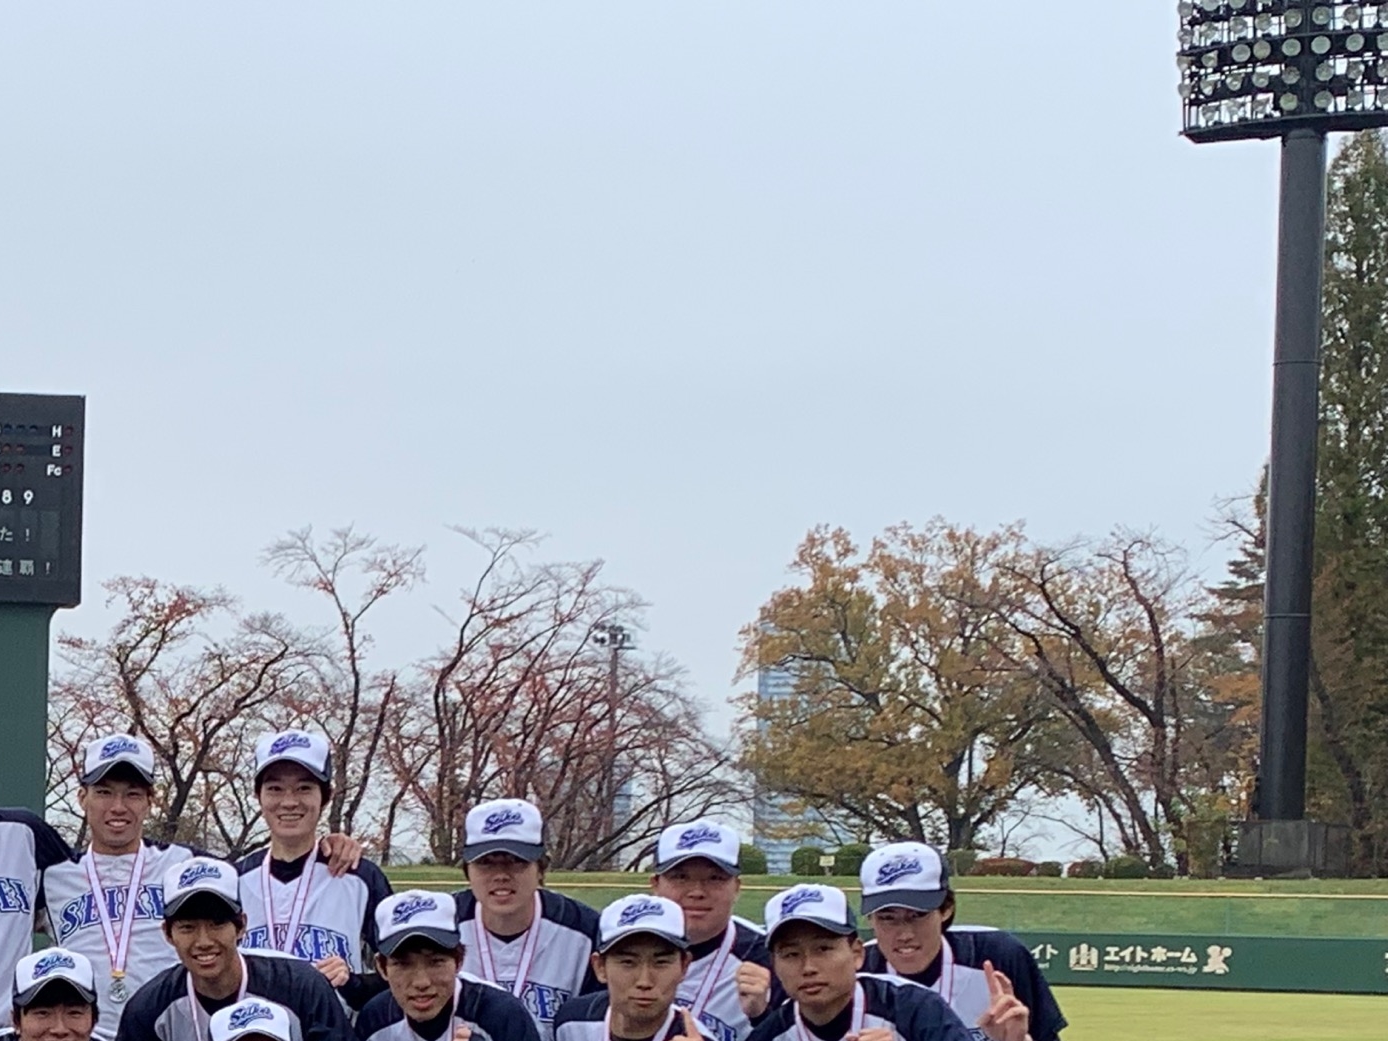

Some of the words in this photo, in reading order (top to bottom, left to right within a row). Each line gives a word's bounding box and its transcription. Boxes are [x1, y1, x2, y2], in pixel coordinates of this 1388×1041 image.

[52, 426, 62, 437] H
[52, 445, 61, 457] E
[2, 489, 13, 504] 8
[23, 490, 34, 505] 9
[61, 884, 164, 944] SEIKE
[1103, 945, 1198, 963] エイトホーム
